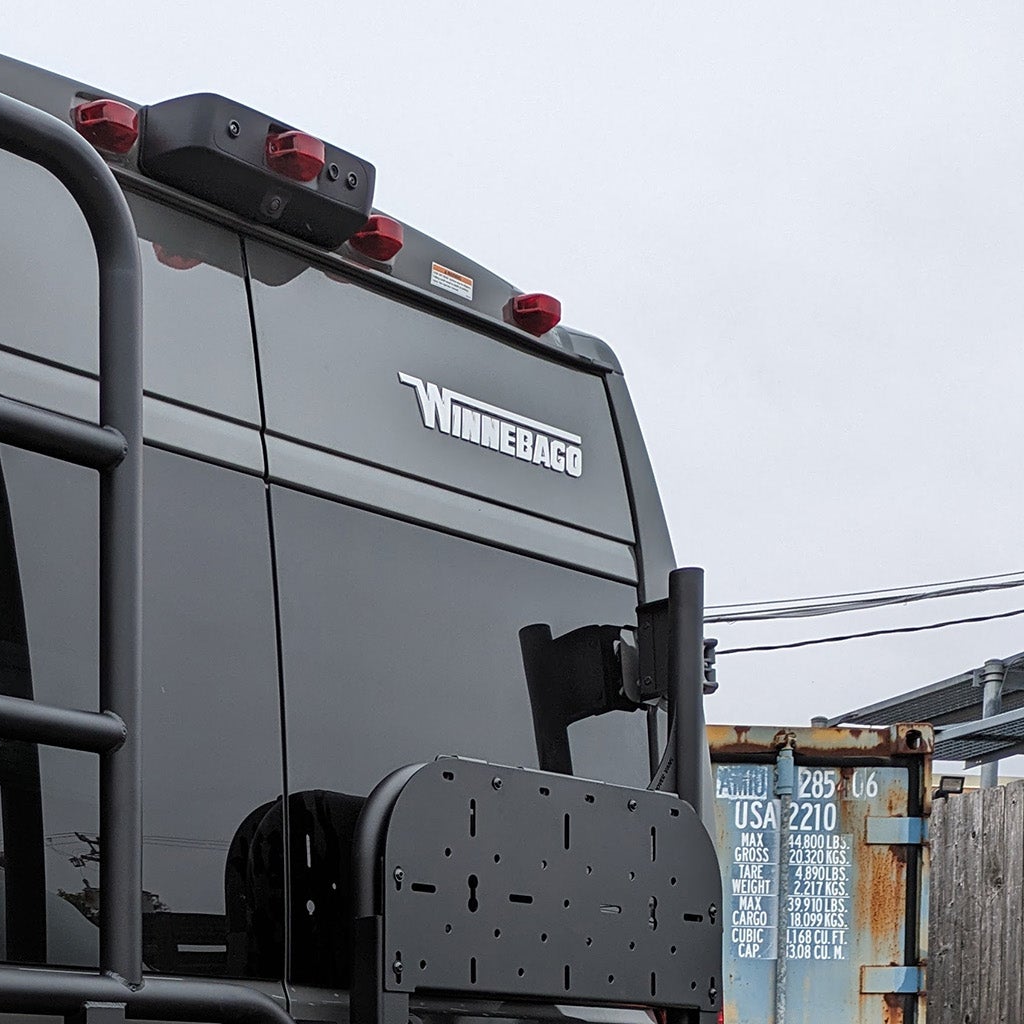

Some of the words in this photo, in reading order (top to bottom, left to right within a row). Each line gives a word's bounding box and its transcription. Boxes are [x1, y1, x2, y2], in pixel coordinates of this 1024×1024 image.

[397, 371, 583, 478] WINNEBAGO
[735, 801, 776, 829] USA
[788, 802, 837, 831] 2210
[741, 833, 764, 847] MAX
[734, 847, 769, 862] GROSS
[825, 850, 850, 865] KGS.
[738, 864, 763, 879] TARE
[825, 867, 849, 881] LBS.
[732, 879, 771, 894] WEIGHT
[825, 881, 849, 896] KGS.
[739, 896, 762, 910] MAX
[825, 898, 848, 912] LBS.
[732, 911, 767, 926] CARGO
[825, 913, 848, 927] KGS.
[732, 928, 764, 943] CUBIC
[814, 930, 830, 945] CU.
[831, 930, 847, 945] FT.
[738, 943, 761, 958] CAP.
[814, 945, 831, 960] CU.
